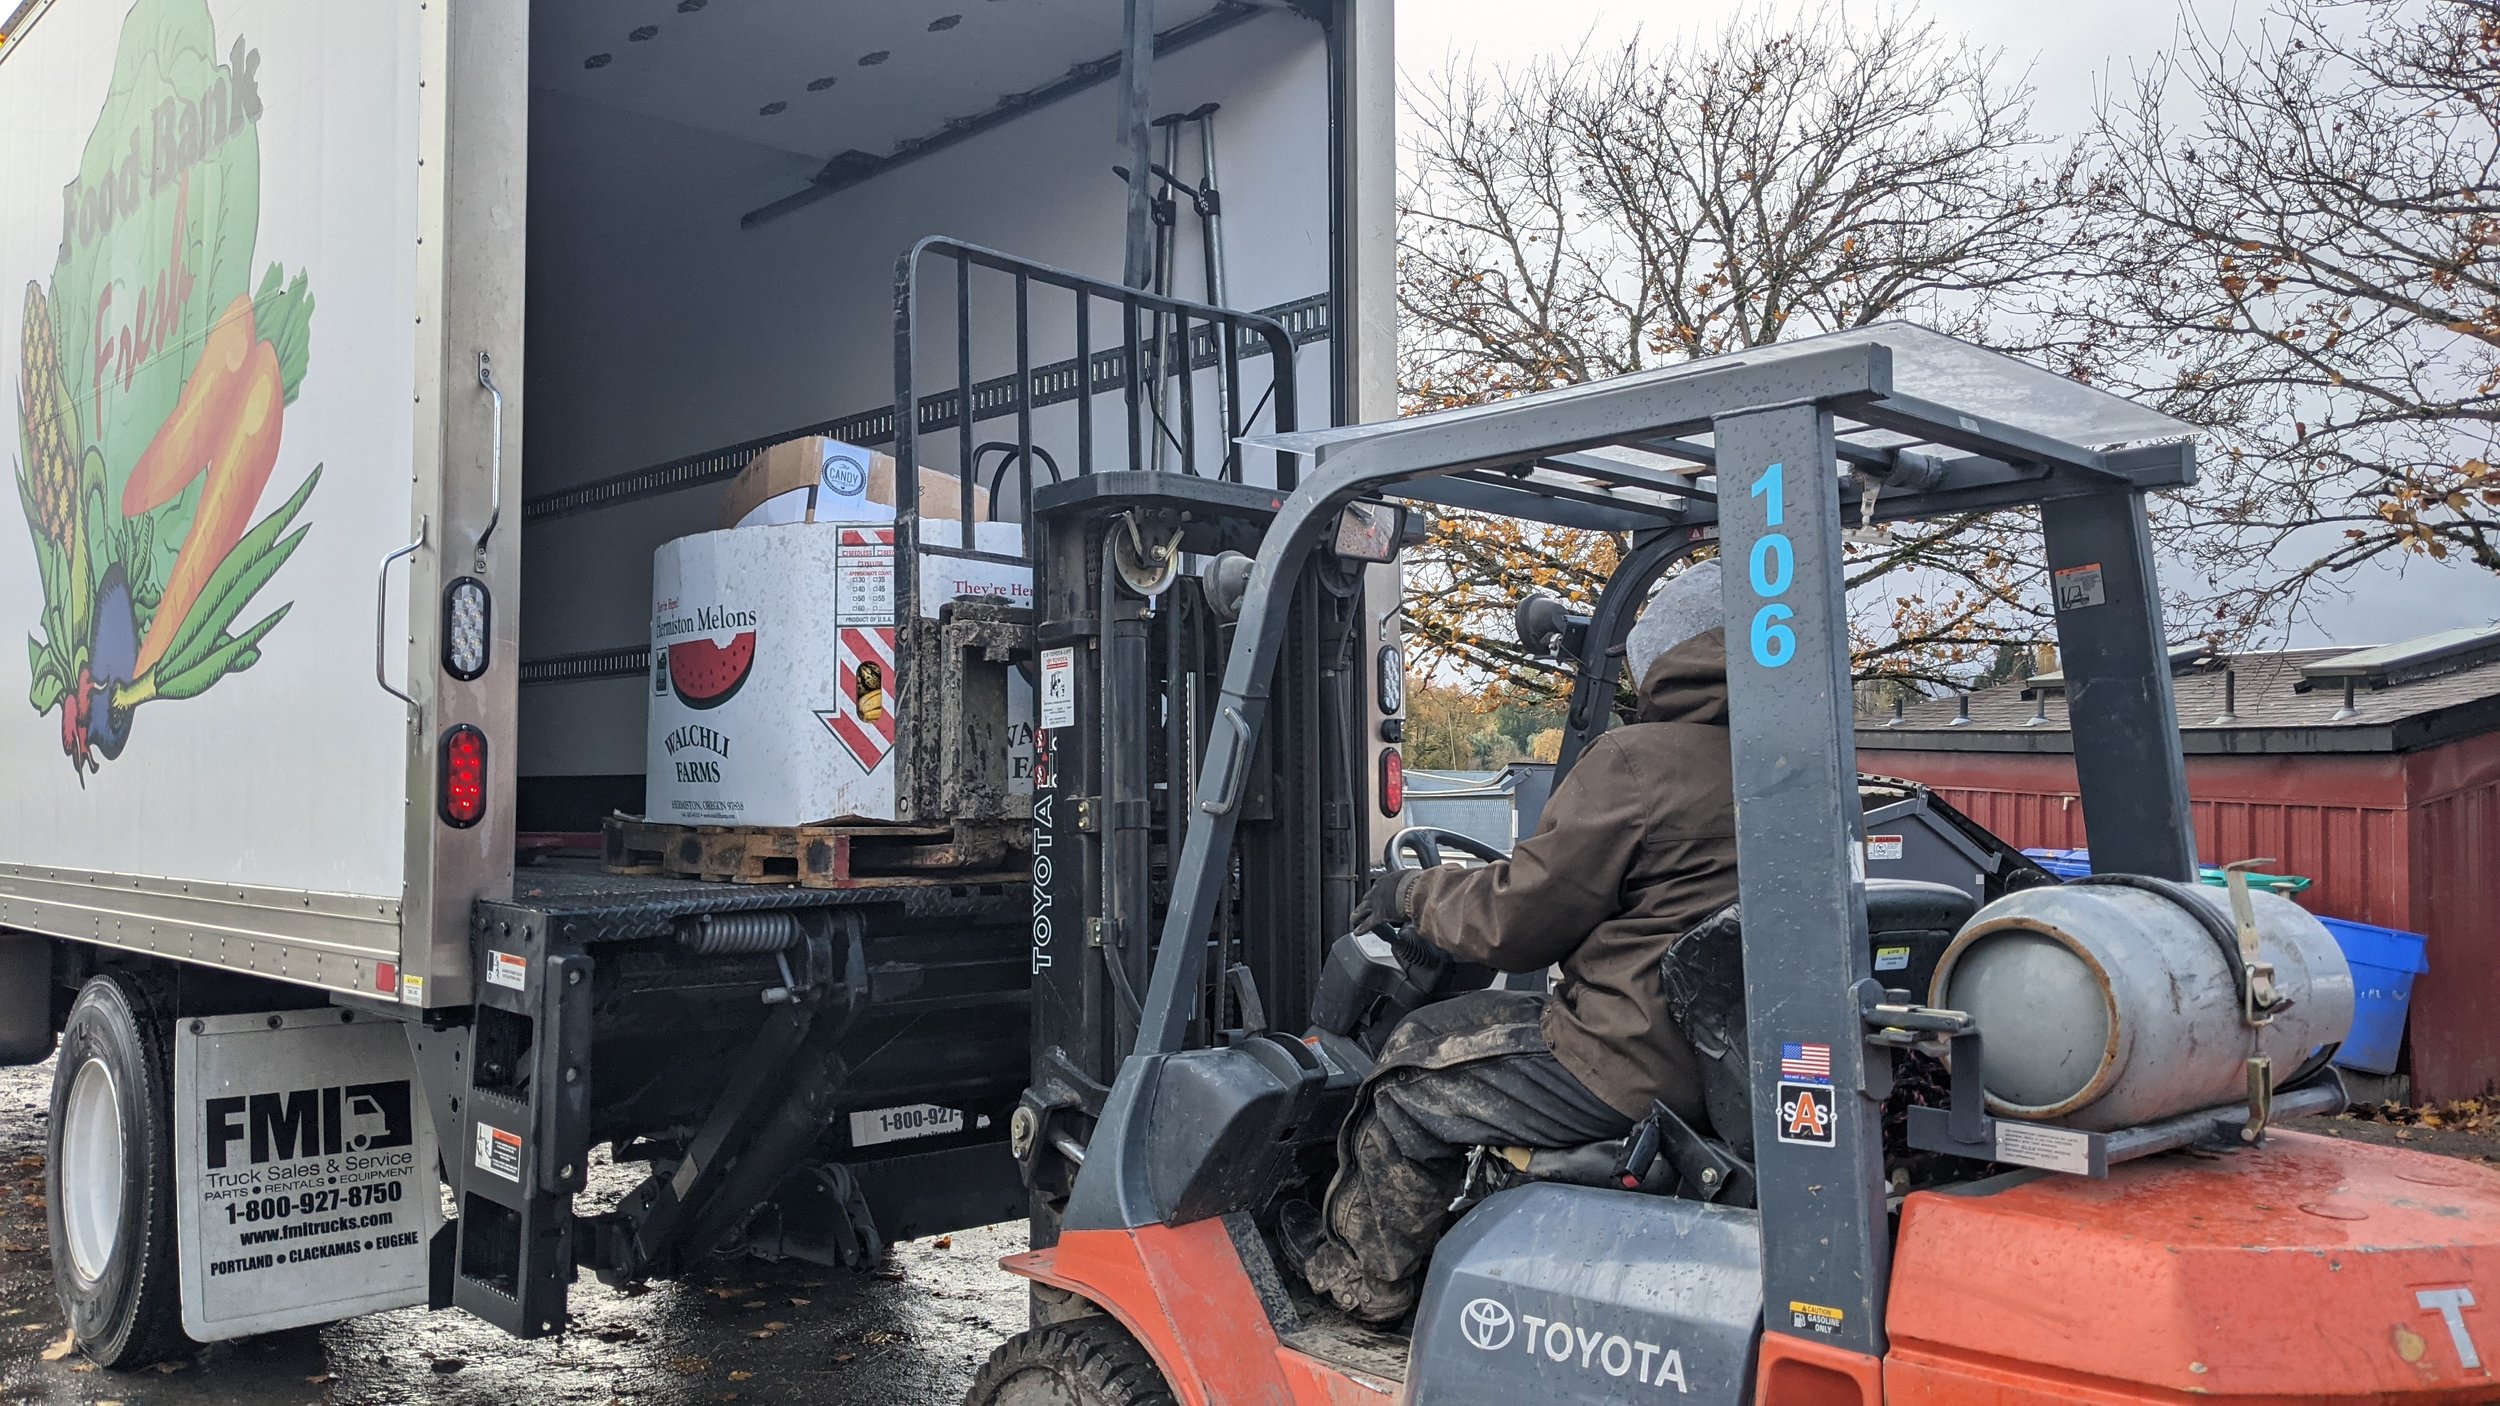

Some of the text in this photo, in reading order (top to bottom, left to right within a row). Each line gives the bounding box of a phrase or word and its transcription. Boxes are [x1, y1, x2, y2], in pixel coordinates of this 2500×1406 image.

[59, 32, 264, 266] Food Bank
[92, 168, 198, 442] Fresh
[829, 467, 859, 484] CANDY
[1749, 463, 1796, 668] 106
[953, 581, 1033, 597] They're Her
[656, 604, 757, 639] Hermiston Melons
[664, 724, 730, 759] WALCHLI
[675, 761, 720, 783] FARMS
[703, 800, 727, 810] OREGON
[1033, 794, 1053, 974] TOYOTA
[206, 1087, 342, 1169] FMI
[1783, 1091, 1828, 1136] SAS
[205, 1166, 415, 1201] PARTS RENTALS EQUIPMENT
[206, 1152, 412, 1188] Truck Sales & Service
[225, 1180, 402, 1225] 1-800-927-8750
[211, 1231, 419, 1276] PORTLAND CLACKAMAS EUGENE
[1807, 1305, 1832, 1316] CAUTION
[1807, 1314, 1840, 1327] GASOLINE
[1815, 1324, 1832, 1334] ONLY
[1522, 1314, 1688, 1394] TOYOTA
